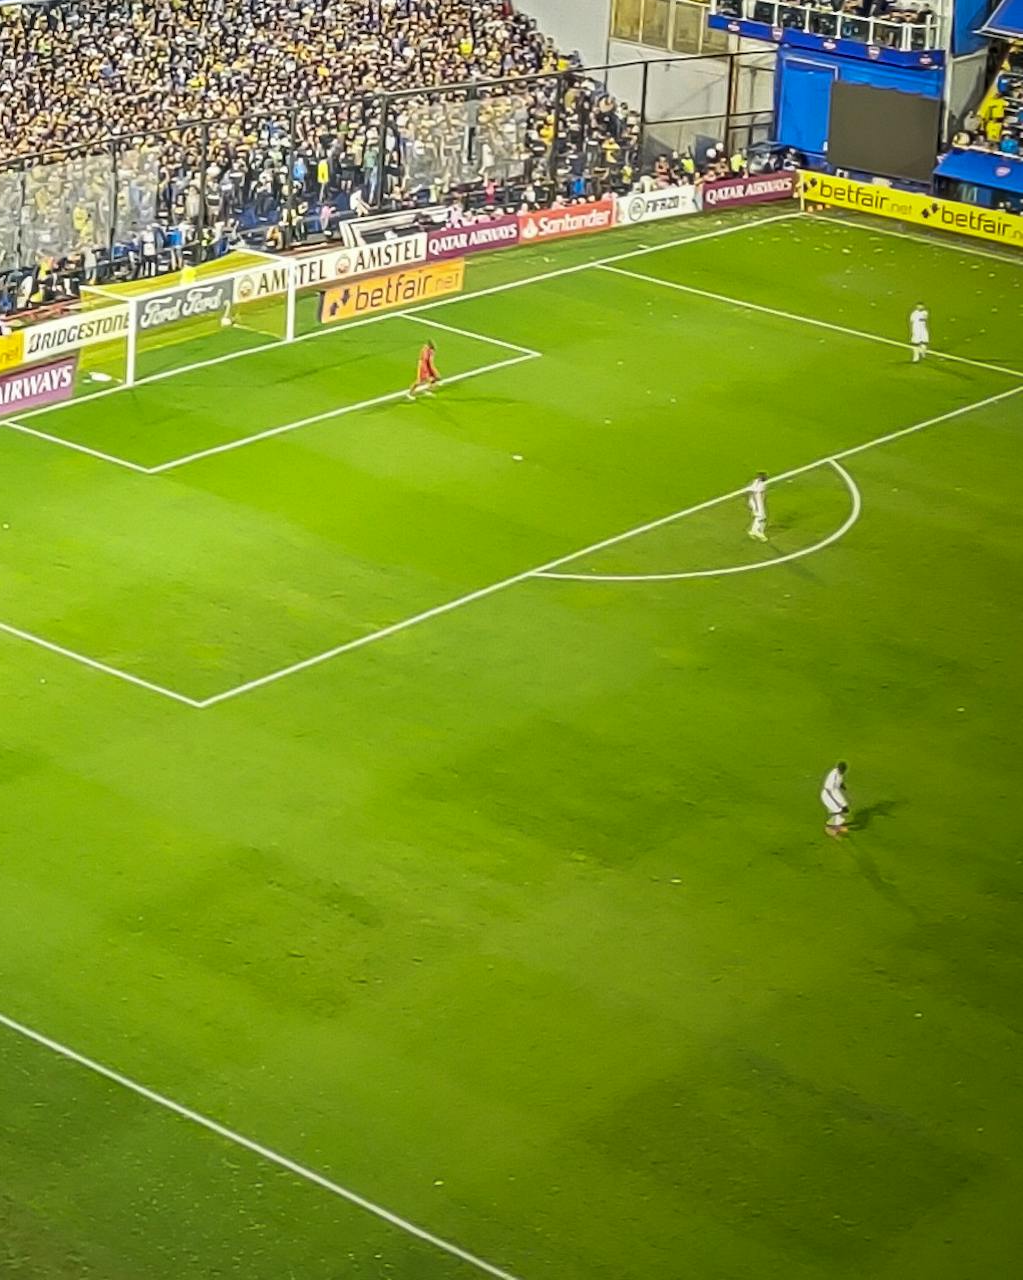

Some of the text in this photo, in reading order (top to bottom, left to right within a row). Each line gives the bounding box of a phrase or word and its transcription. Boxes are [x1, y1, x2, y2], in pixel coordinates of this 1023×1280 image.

[705, 184, 744, 205] QATAR
[745, 177, 793, 197] AIRWAYS
[428, 223, 518, 256] QATAR AIRWAYS
[538, 209, 611, 236] Santander
[353, 238, 422, 273] AMSTEL
[257, 259, 326, 295] AMTEL
[140, 285, 224, 329] Ford Ford
